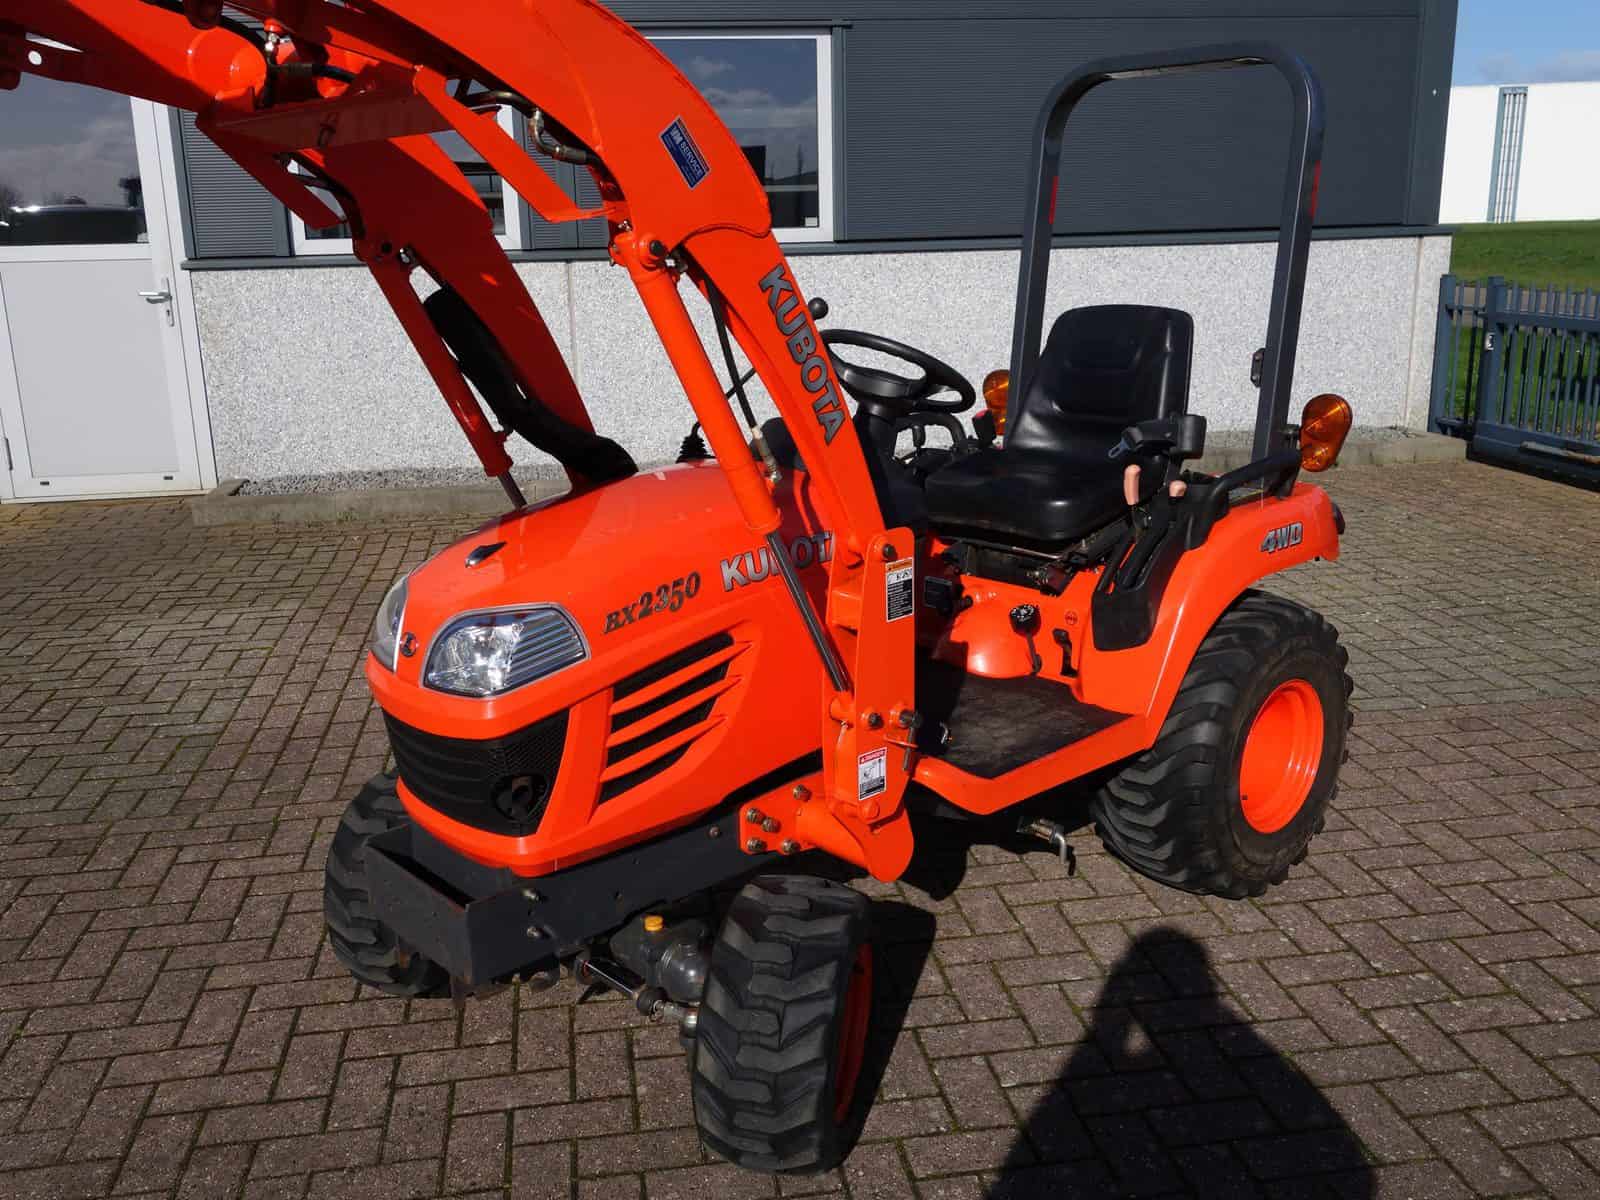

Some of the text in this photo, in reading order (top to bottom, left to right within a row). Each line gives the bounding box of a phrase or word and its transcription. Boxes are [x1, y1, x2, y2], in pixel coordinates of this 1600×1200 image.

[758, 264, 846, 446] KUBOTA
[719, 530, 835, 592] KUOT
[1260, 521, 1303, 554] 4WD
[603, 571, 701, 634] BX2350
